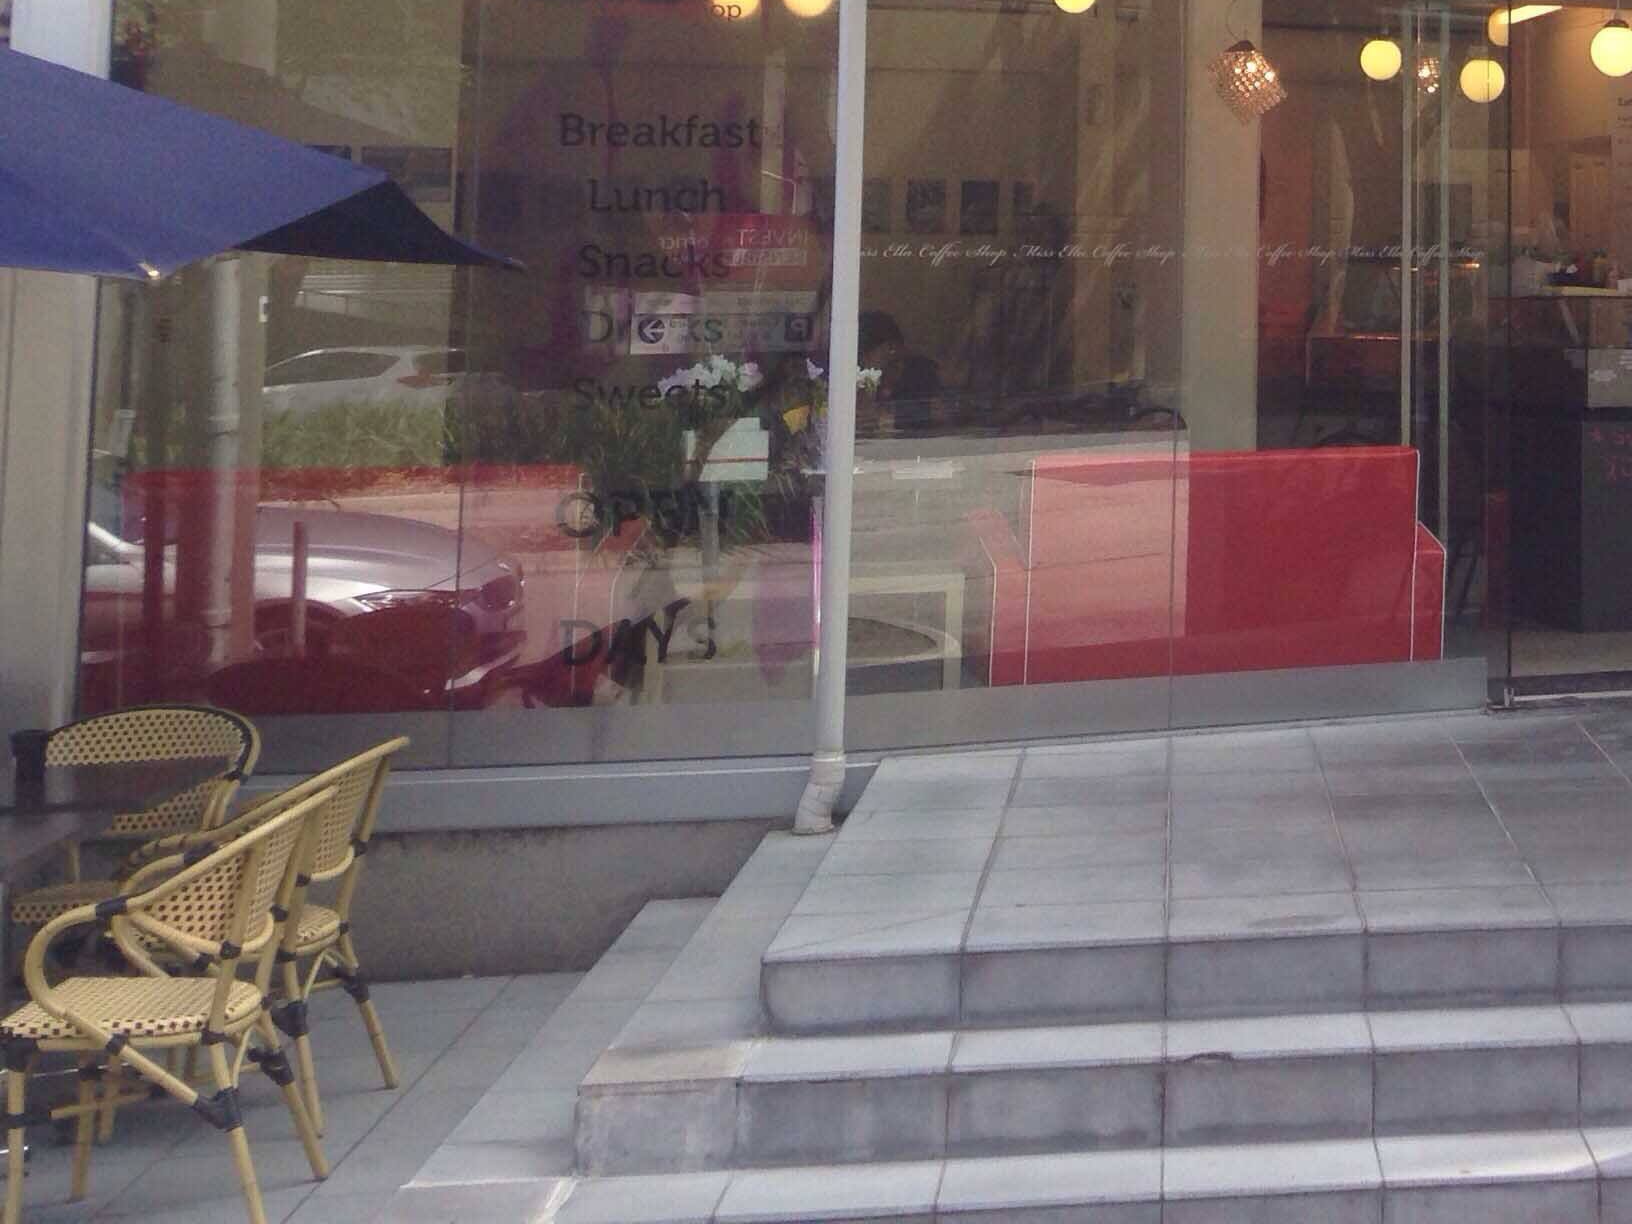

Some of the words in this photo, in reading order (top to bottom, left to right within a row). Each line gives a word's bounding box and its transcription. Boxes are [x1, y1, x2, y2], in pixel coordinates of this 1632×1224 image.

[559, 112, 763, 149] Breakfast
[587, 178, 727, 212] Lunch
[578, 243, 731, 279] Snacks
